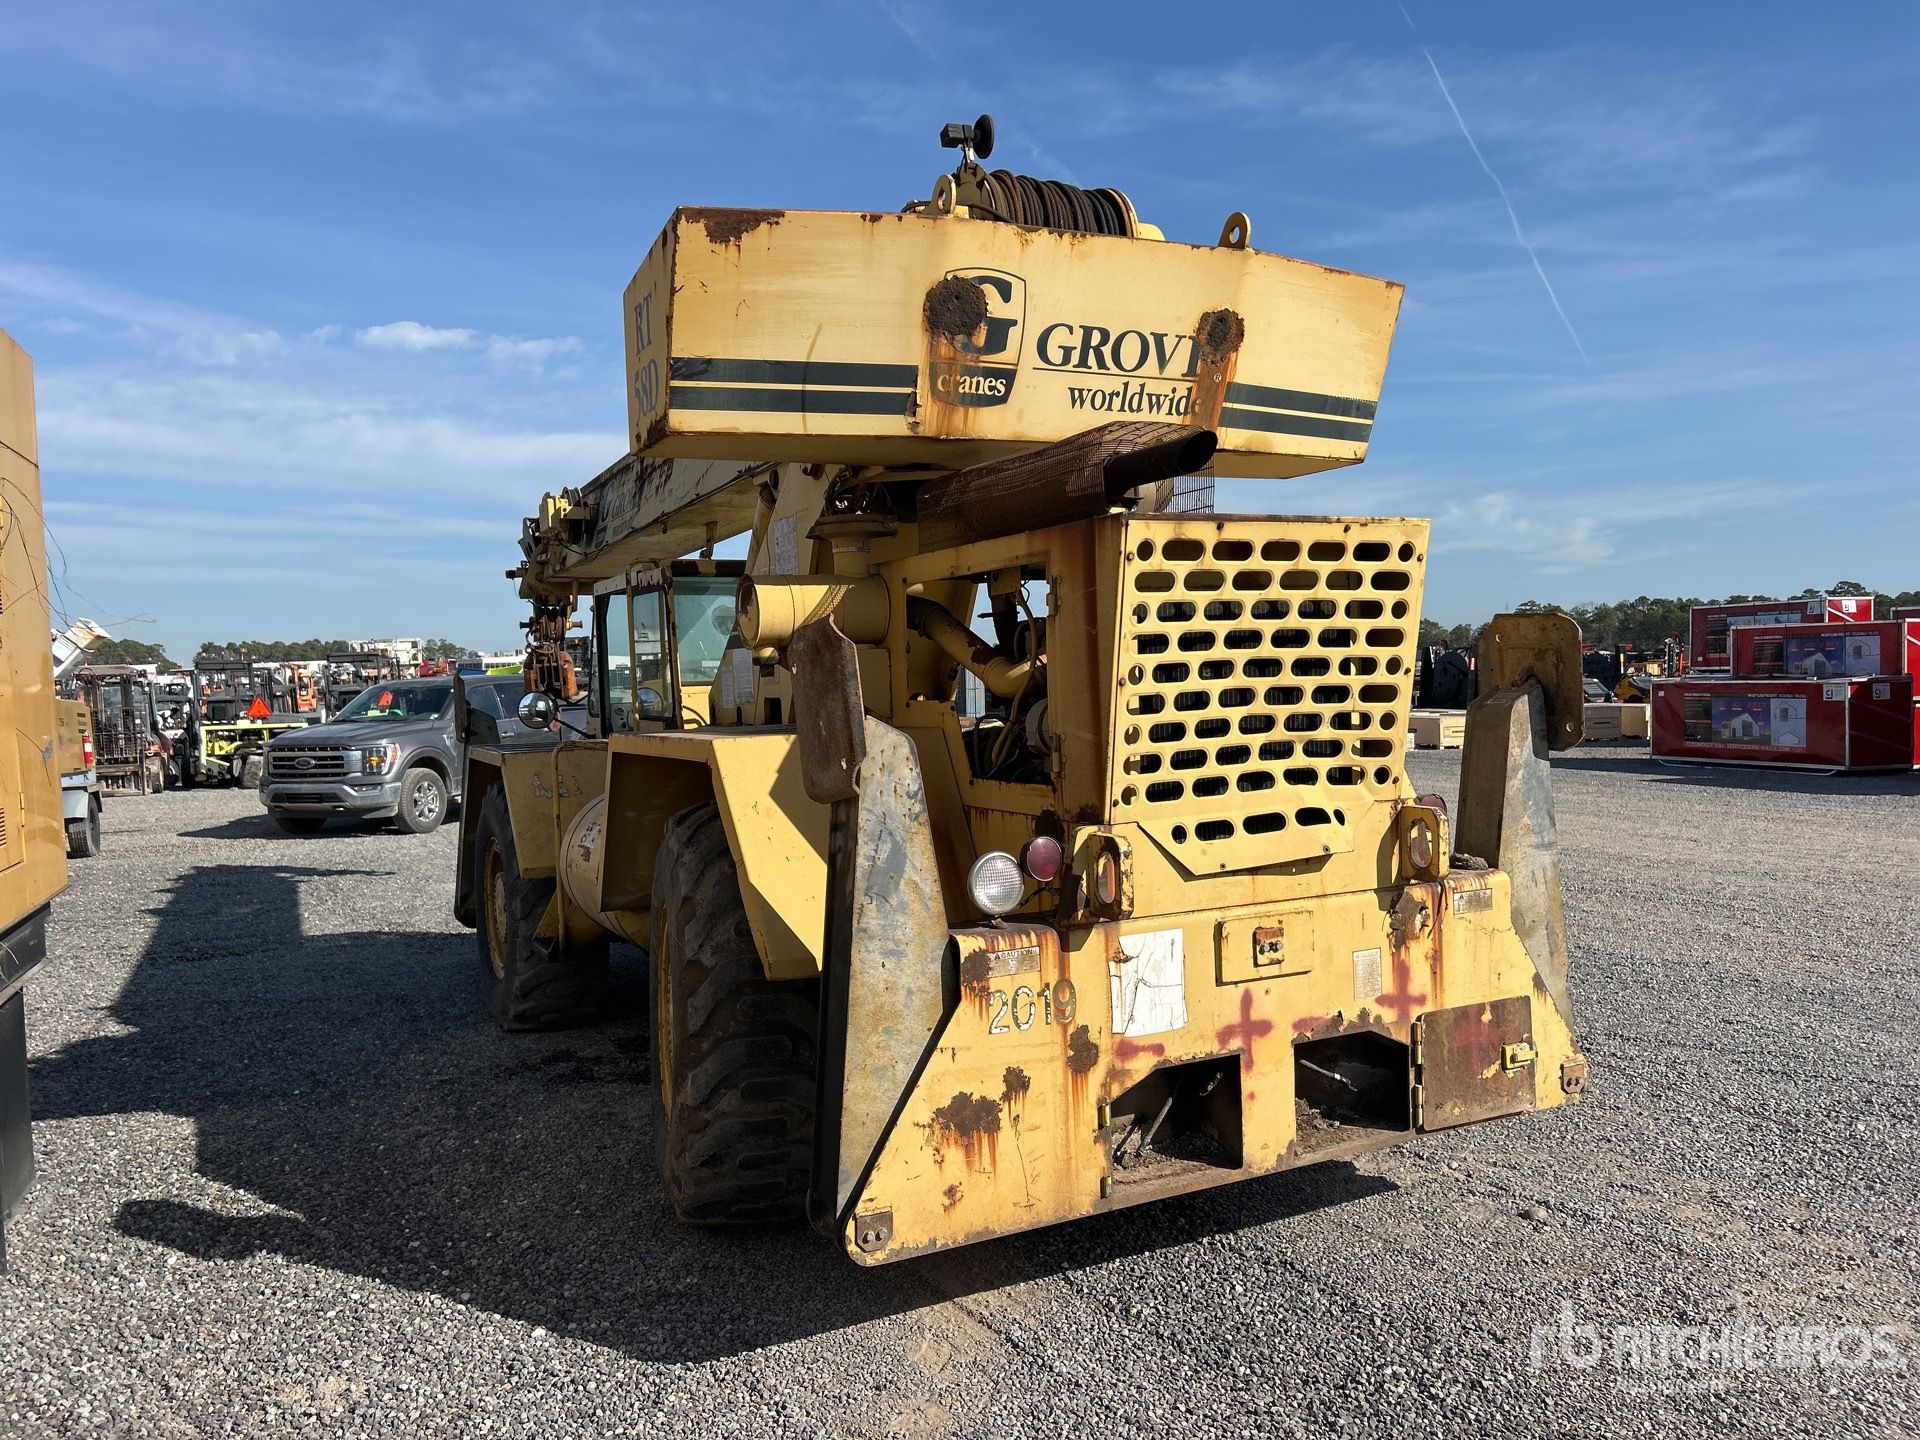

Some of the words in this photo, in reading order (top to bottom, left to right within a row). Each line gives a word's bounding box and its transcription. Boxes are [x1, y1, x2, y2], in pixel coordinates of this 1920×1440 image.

[633, 291, 652, 357] RT
[936, 374, 1007, 396] cranes
[1068, 380, 1203, 417] worldwide
[1001, 948, 1033, 959] CAUTION
[988, 978, 1077, 1034] 2019
